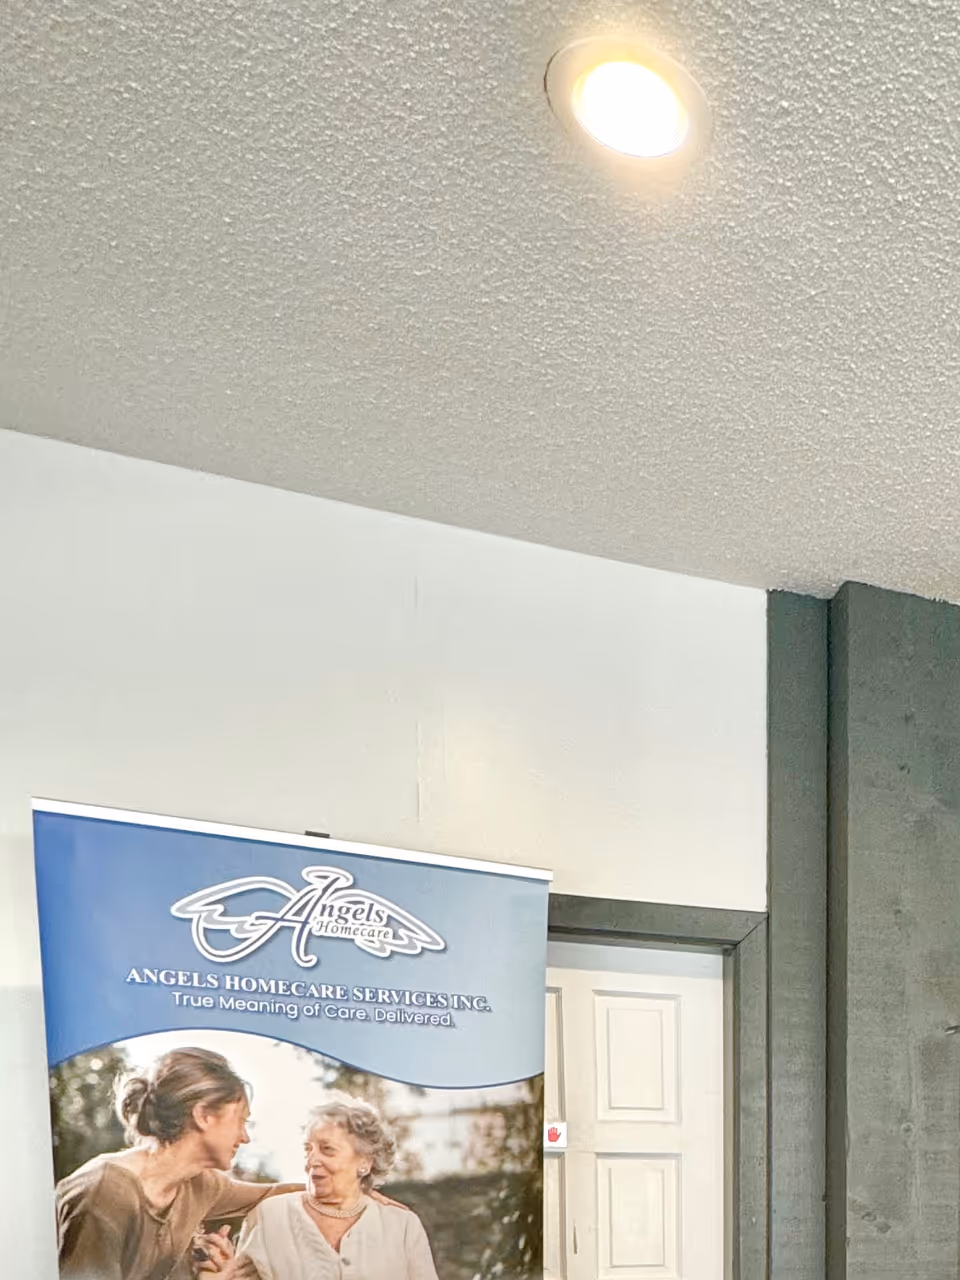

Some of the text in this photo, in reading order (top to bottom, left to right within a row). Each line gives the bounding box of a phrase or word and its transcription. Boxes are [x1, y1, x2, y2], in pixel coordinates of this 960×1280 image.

[316, 919, 392, 940] Homecare
[126, 966, 492, 1012] ANGELS HOMECARE SERVICES INC.
[172, 990, 456, 1028] True Meaning of Care. Delivered.
